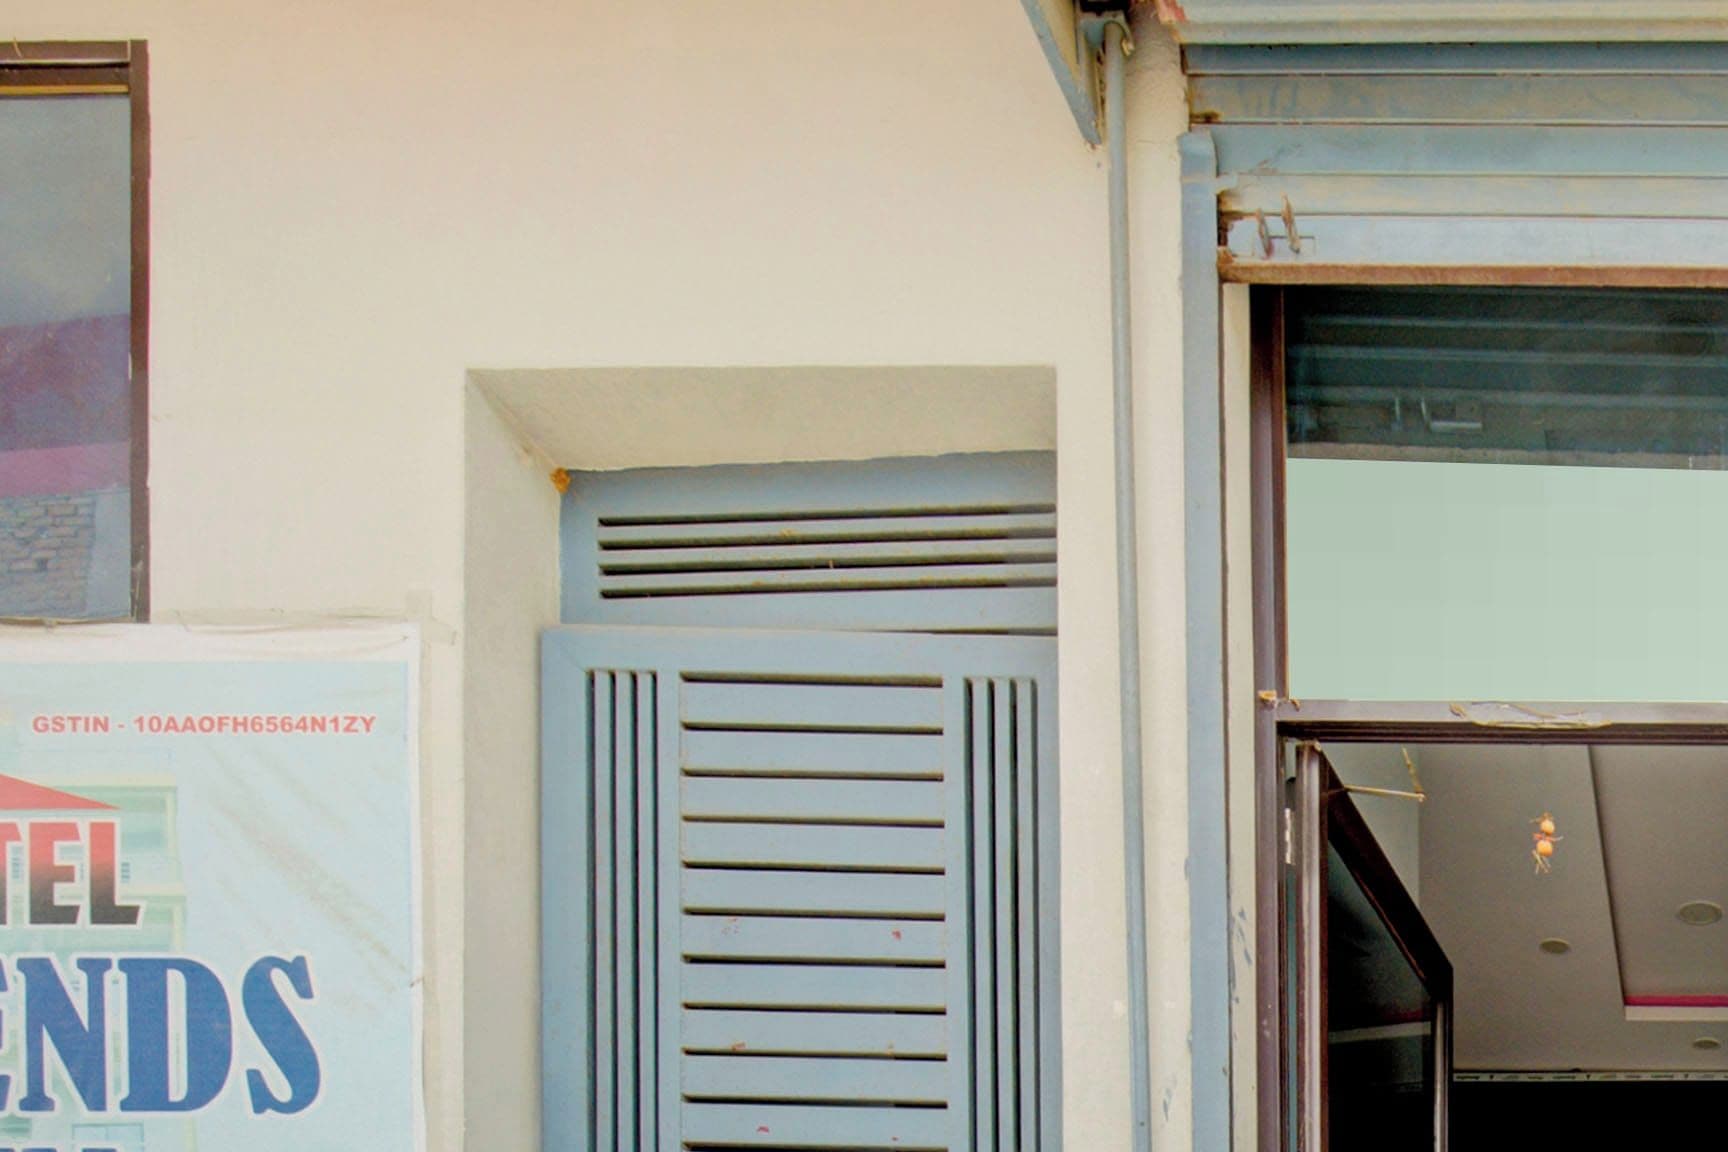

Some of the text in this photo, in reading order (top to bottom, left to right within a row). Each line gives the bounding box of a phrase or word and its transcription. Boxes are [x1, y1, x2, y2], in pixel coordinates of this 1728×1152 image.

[32, 715, 110, 734] GSTIN
[133, 715, 377, 734] 10AAOFH6564N1ZY
[0, 955, 321, 1115] NDS
